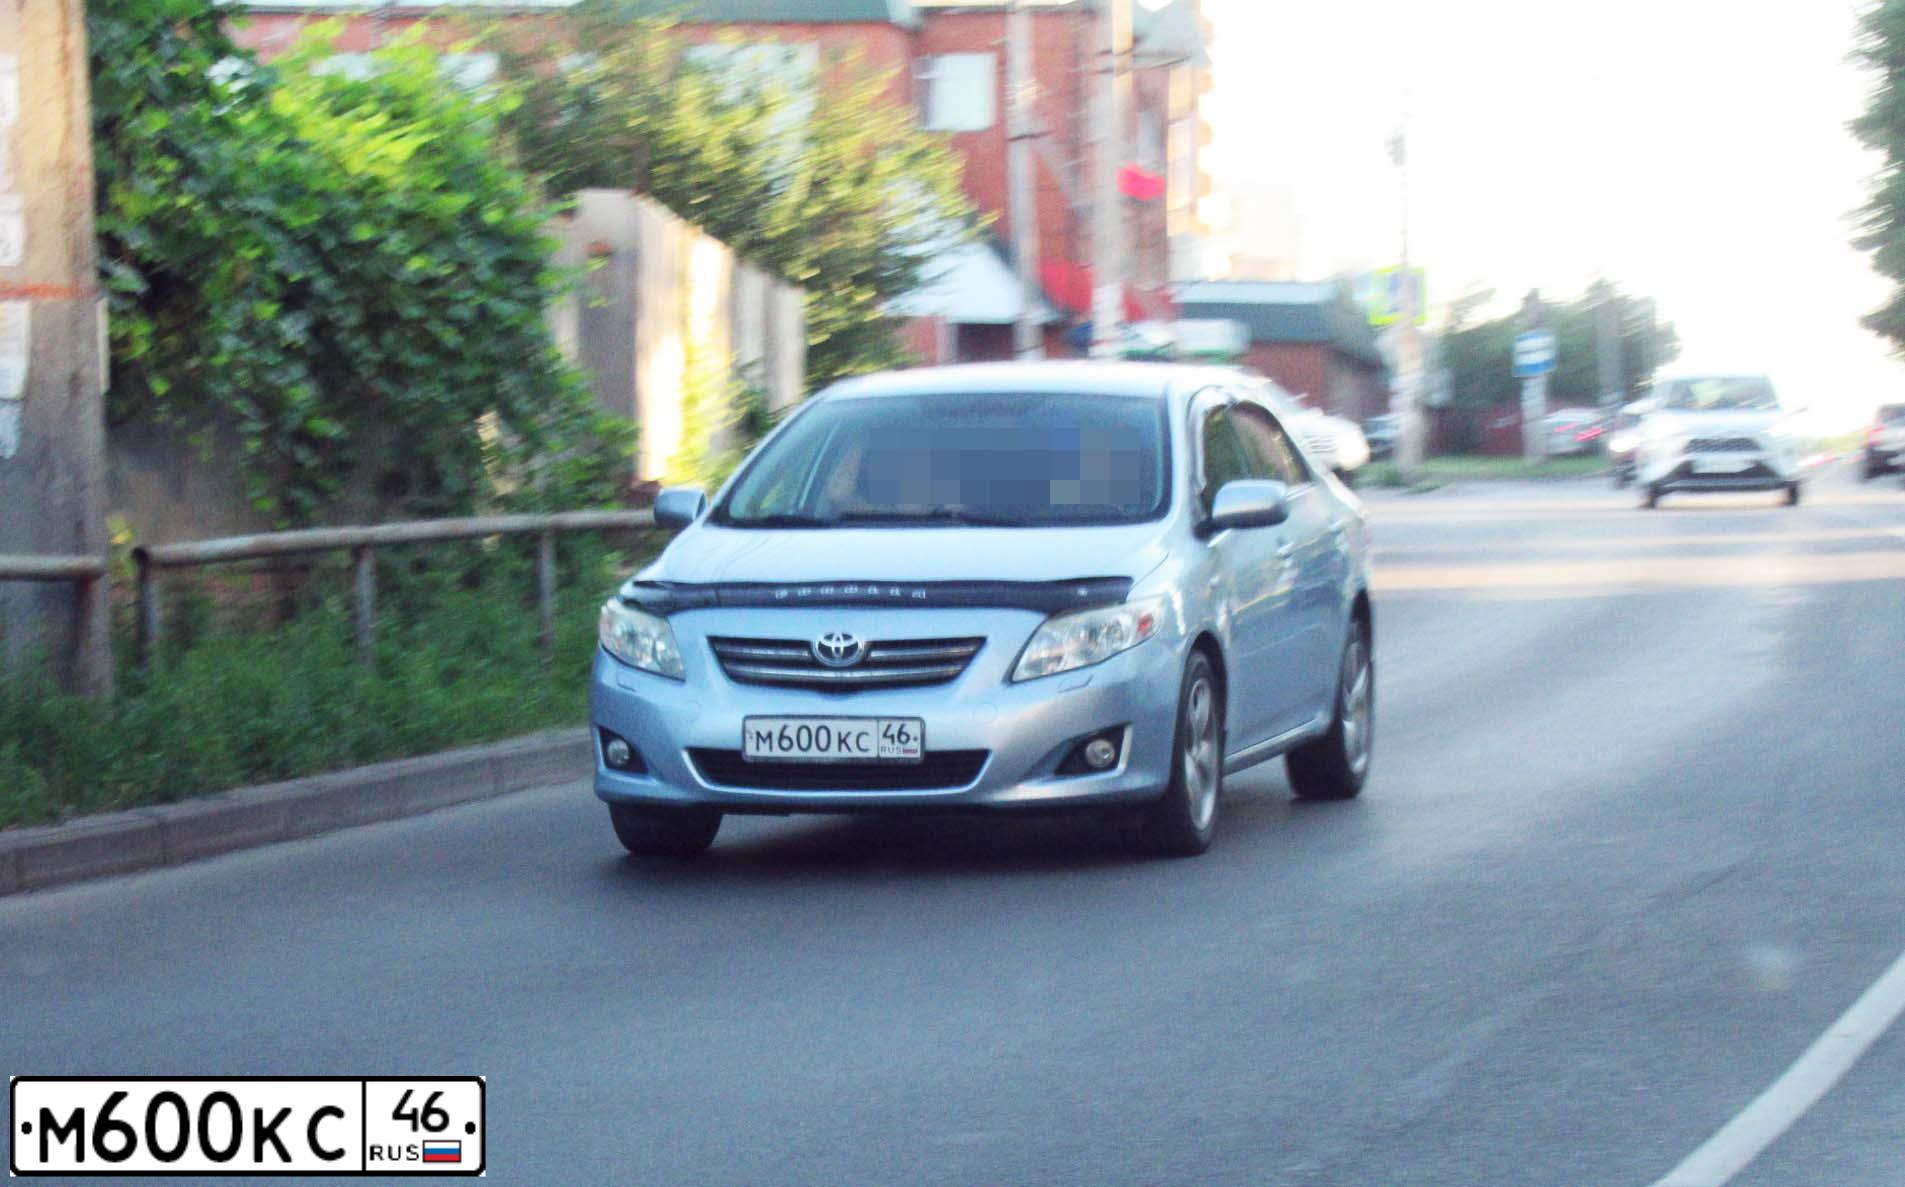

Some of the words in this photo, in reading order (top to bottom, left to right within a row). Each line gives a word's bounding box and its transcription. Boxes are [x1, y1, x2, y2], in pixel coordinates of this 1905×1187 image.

[755, 724, 870, 752] M600KC
[882, 723, 911, 745] 46
[880, 746, 902, 754] RUS
